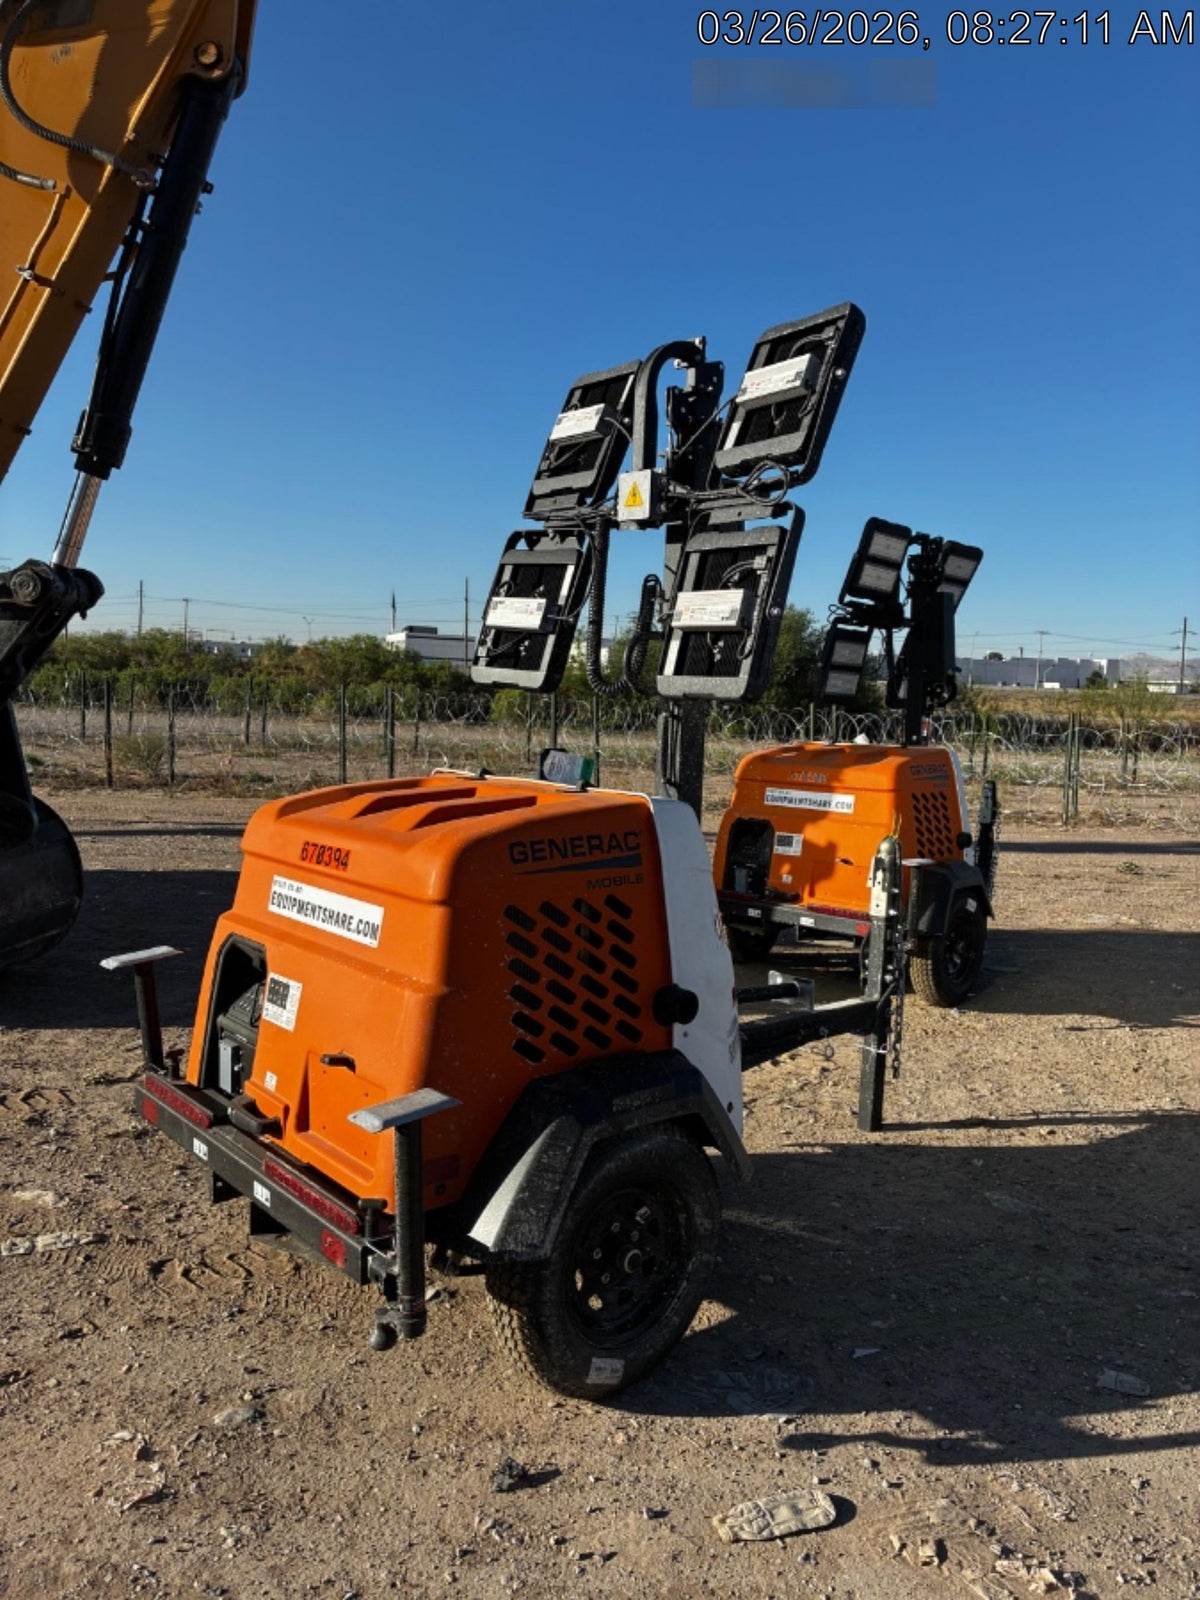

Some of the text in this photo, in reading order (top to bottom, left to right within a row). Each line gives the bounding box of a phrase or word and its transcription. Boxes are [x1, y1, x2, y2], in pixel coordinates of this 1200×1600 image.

[300, 840, 351, 871] 678394
[508, 831, 641, 864] GENERAC
[586, 873, 645, 890] MOBILE
[270, 890, 380, 942] EQUIPMENTSHARE.COM
